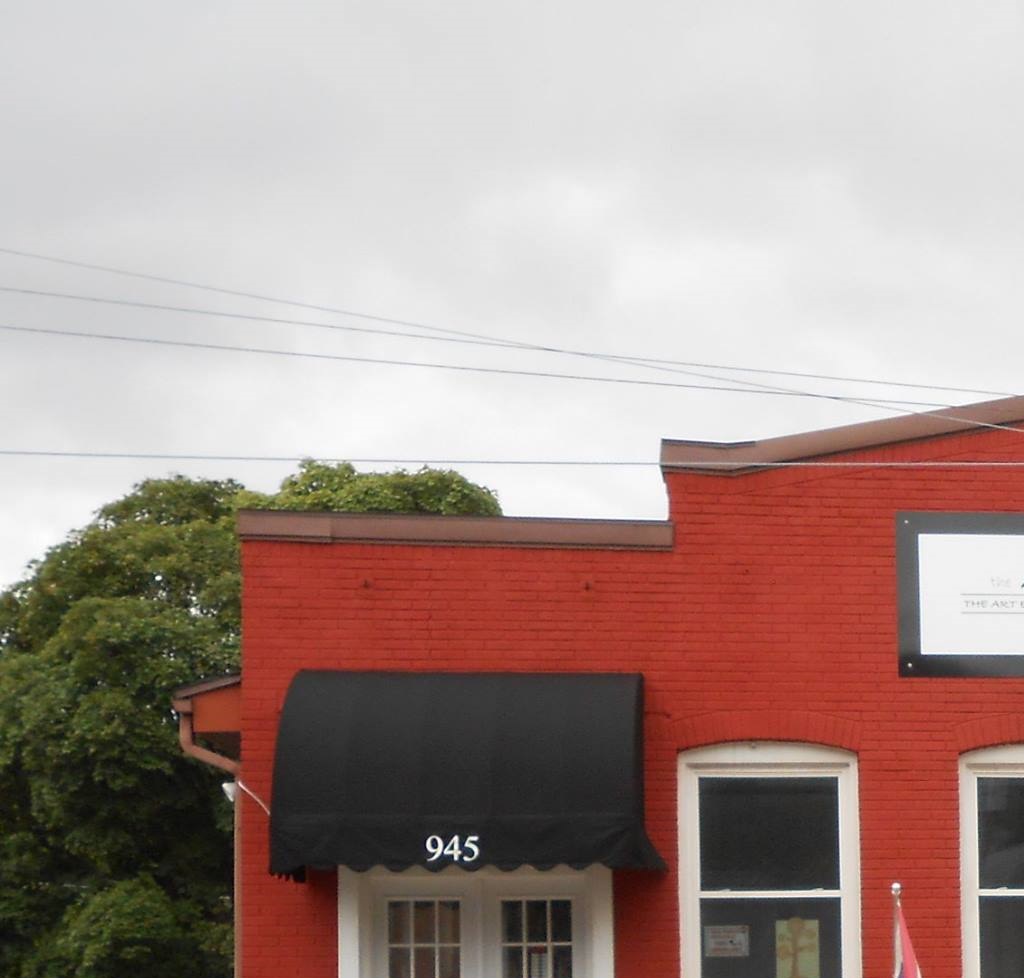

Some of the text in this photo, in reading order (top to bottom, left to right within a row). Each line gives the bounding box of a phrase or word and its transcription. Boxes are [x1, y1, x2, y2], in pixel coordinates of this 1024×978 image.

[964, 600, 988, 609] THE
[990, 600, 1016, 609] ART
[425, 834, 480, 862] 945
